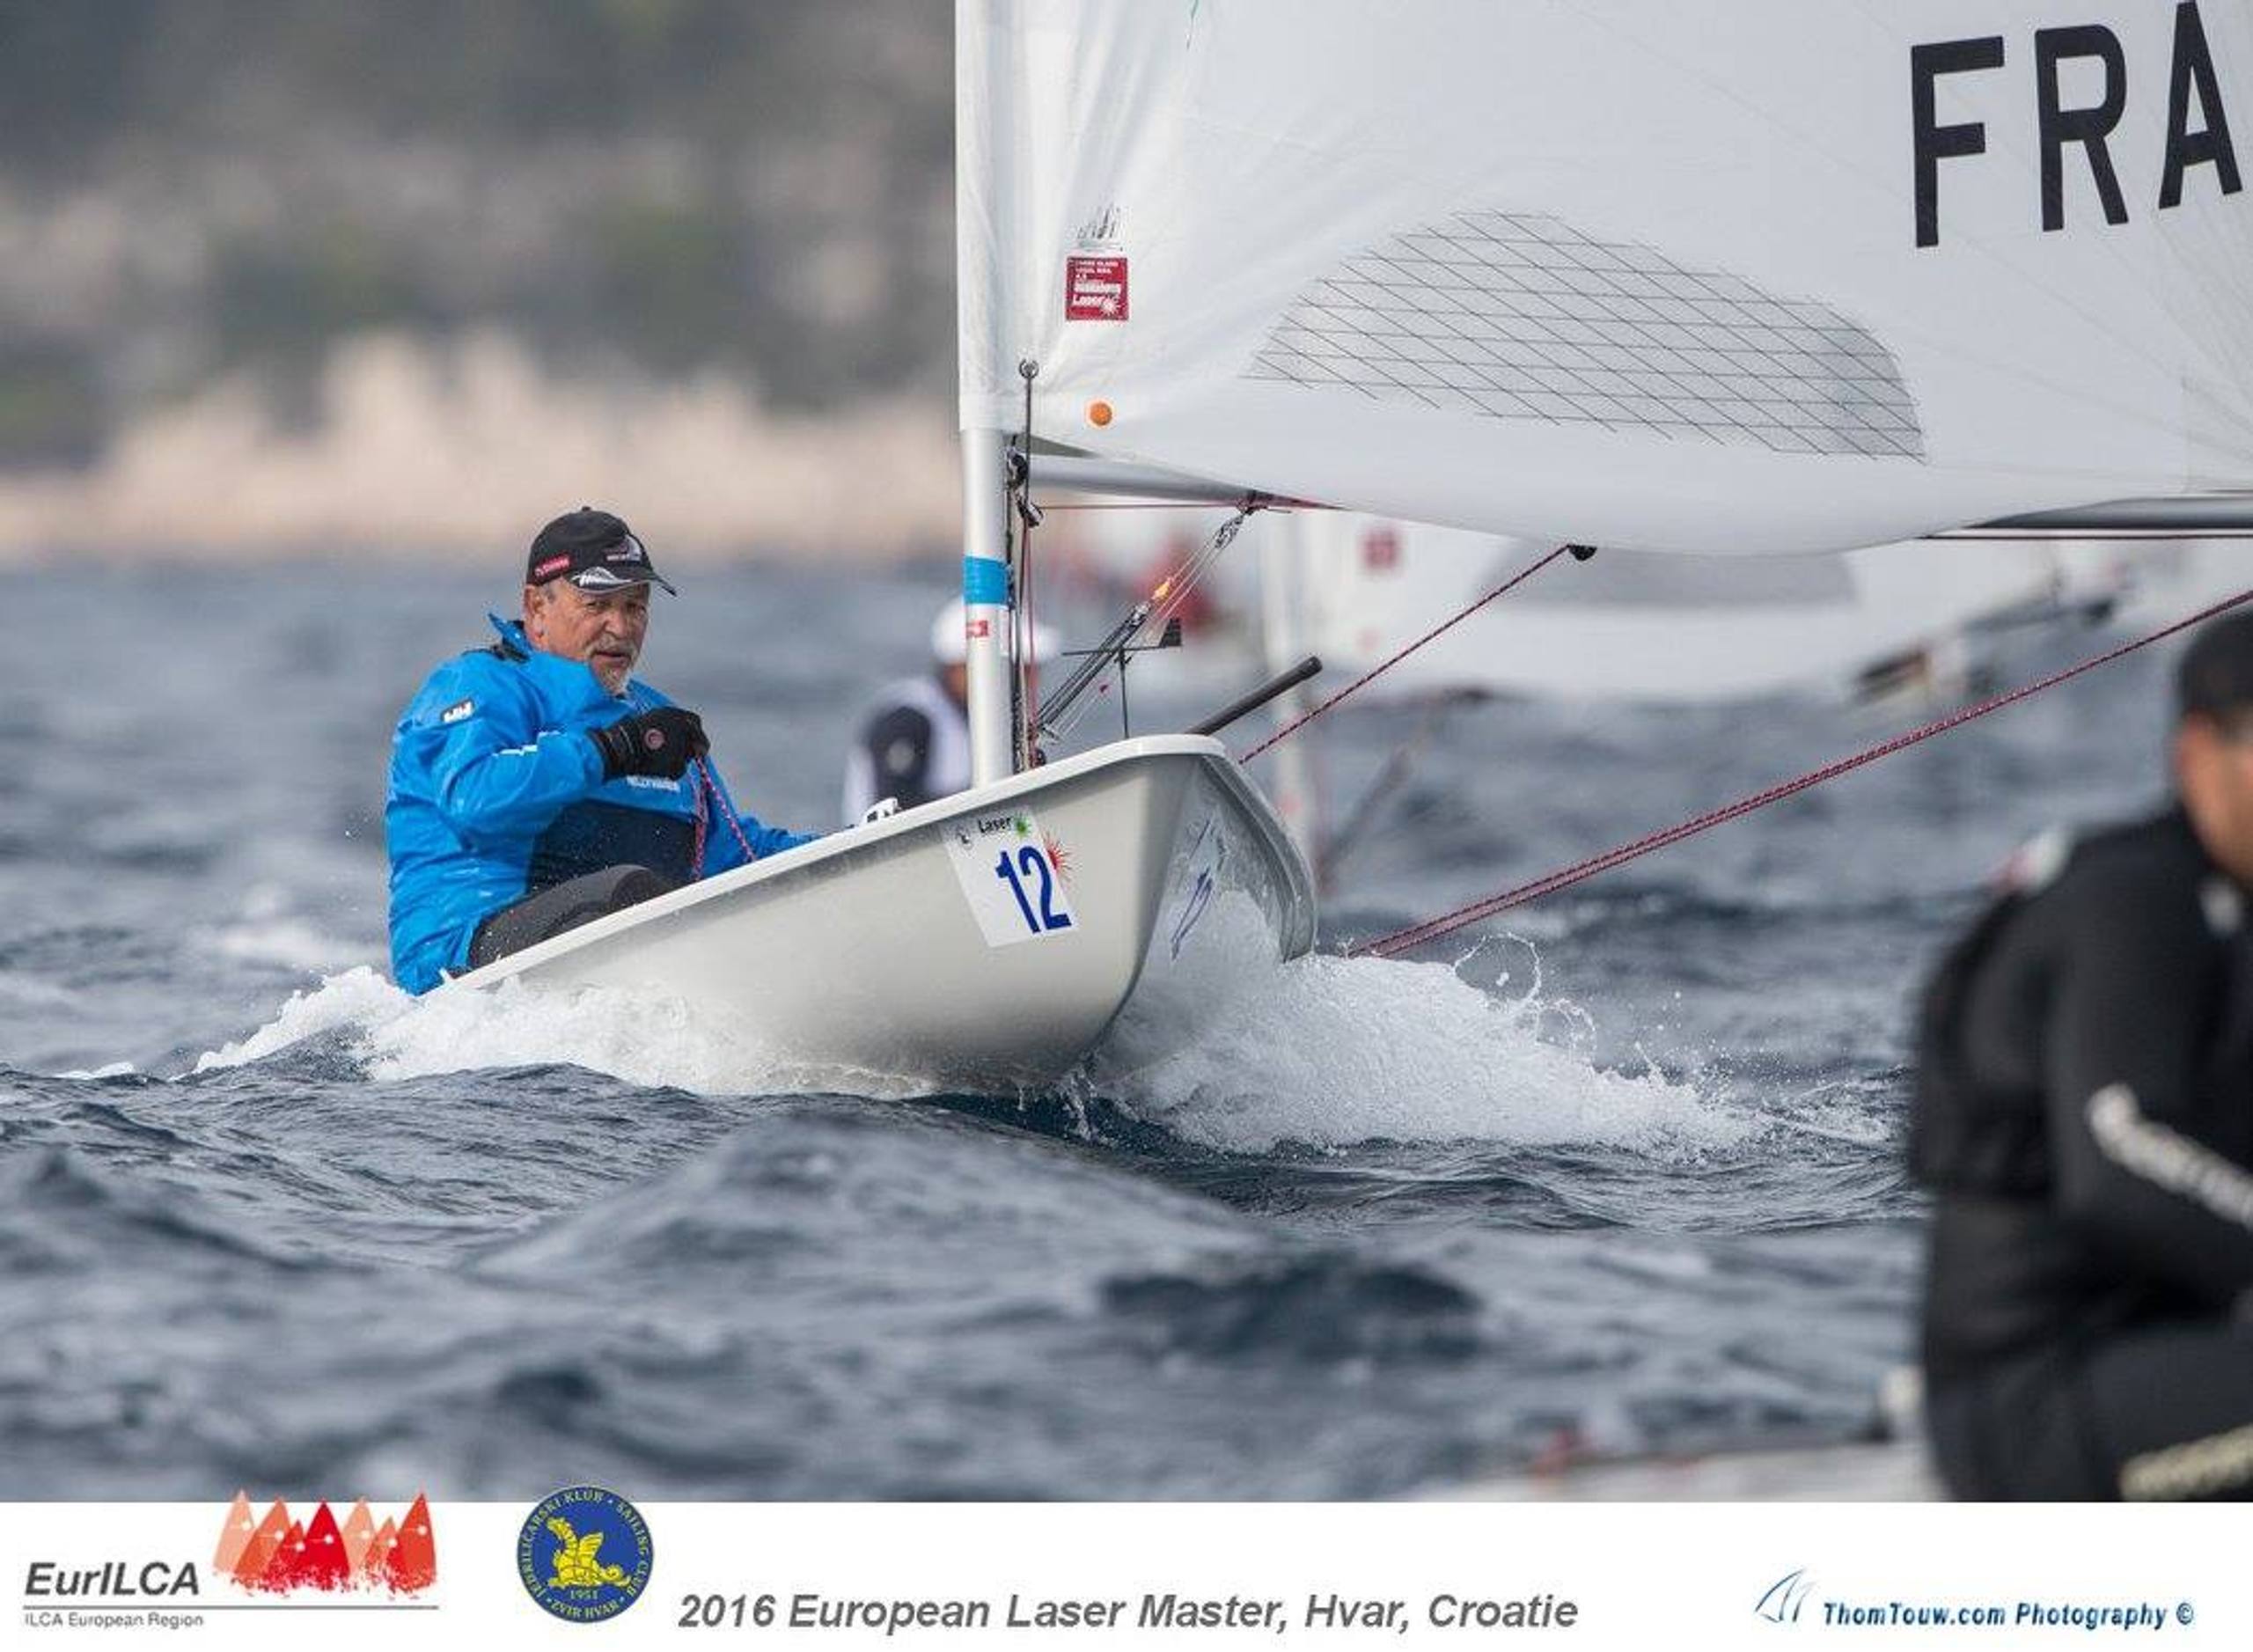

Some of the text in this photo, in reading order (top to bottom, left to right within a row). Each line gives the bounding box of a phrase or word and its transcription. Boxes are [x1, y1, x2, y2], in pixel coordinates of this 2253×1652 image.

[1912, 0, 2243, 247] FRA
[978, 816, 1013, 833] Laser
[995, 845, 1072, 934] 12
